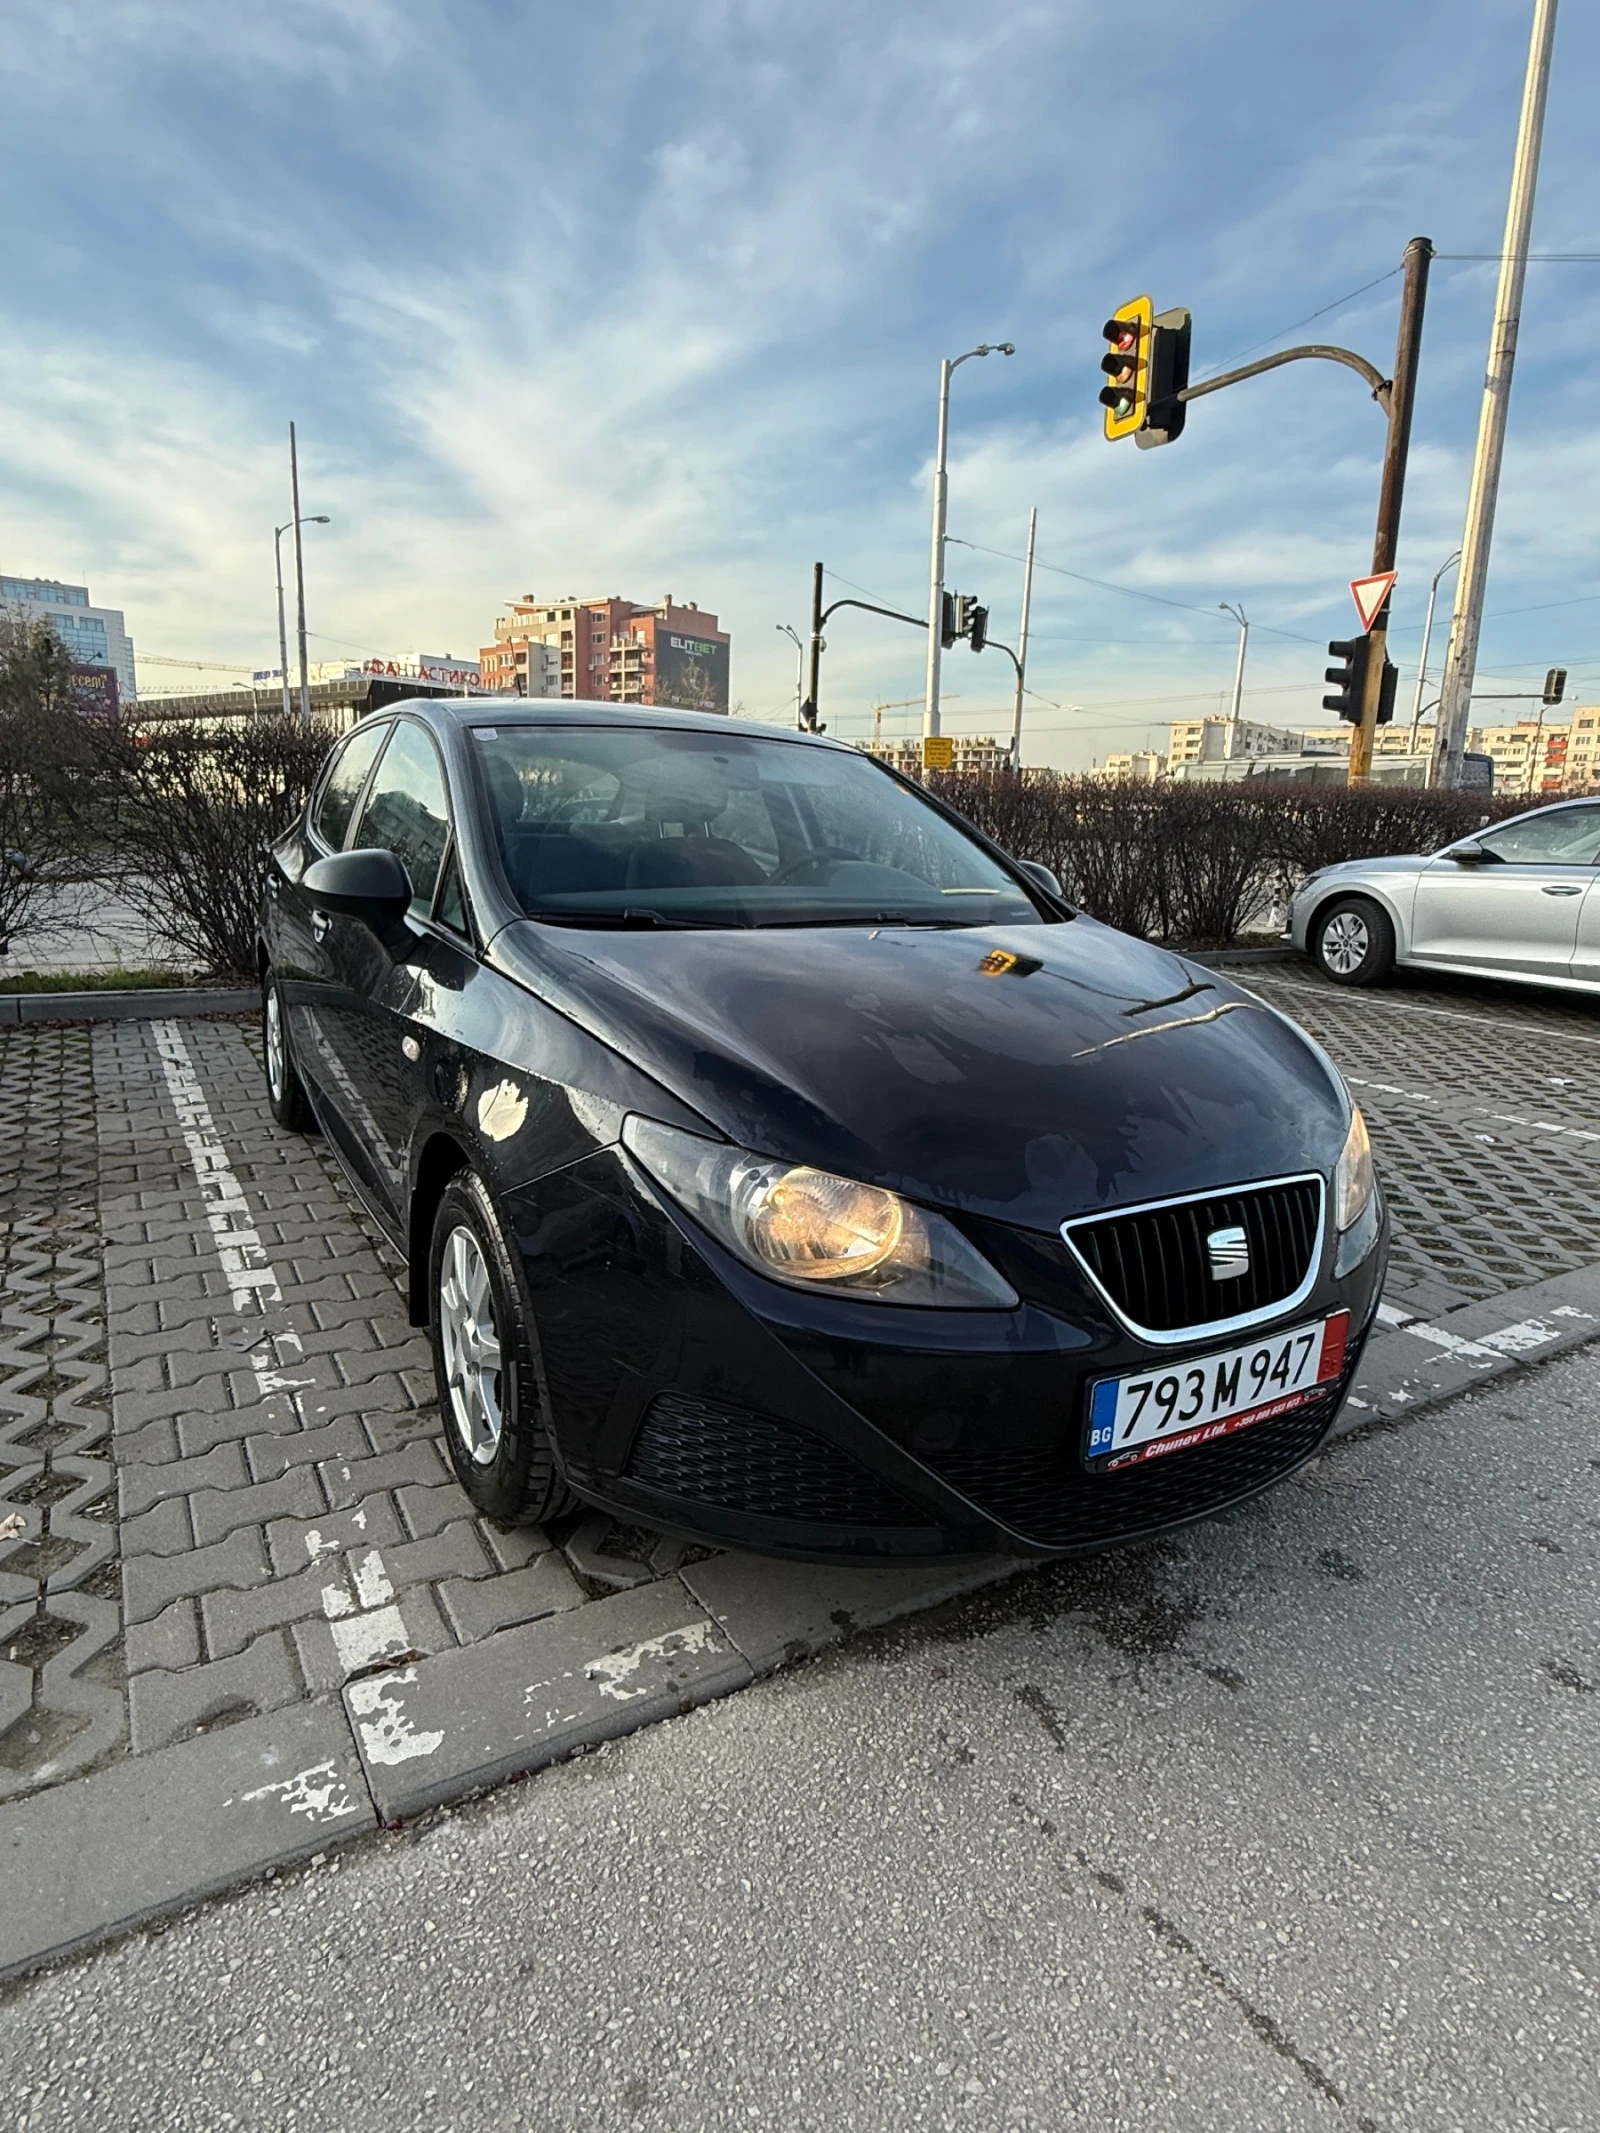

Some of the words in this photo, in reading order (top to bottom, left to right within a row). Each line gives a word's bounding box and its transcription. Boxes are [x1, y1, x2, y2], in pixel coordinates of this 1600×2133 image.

[670, 636, 717, 655] ELITBET
[368, 658, 480, 686] ФАНТАСТИКО
[1090, 1426, 1112, 1446] BG
[1121, 1369, 1206, 1439] 793
[1211, 1356, 1242, 1413] M
[1249, 1332, 1316, 1400] 947
[1144, 1432, 1201, 1458] Chunev
[1202, 1422, 1227, 1440] Ltd.
